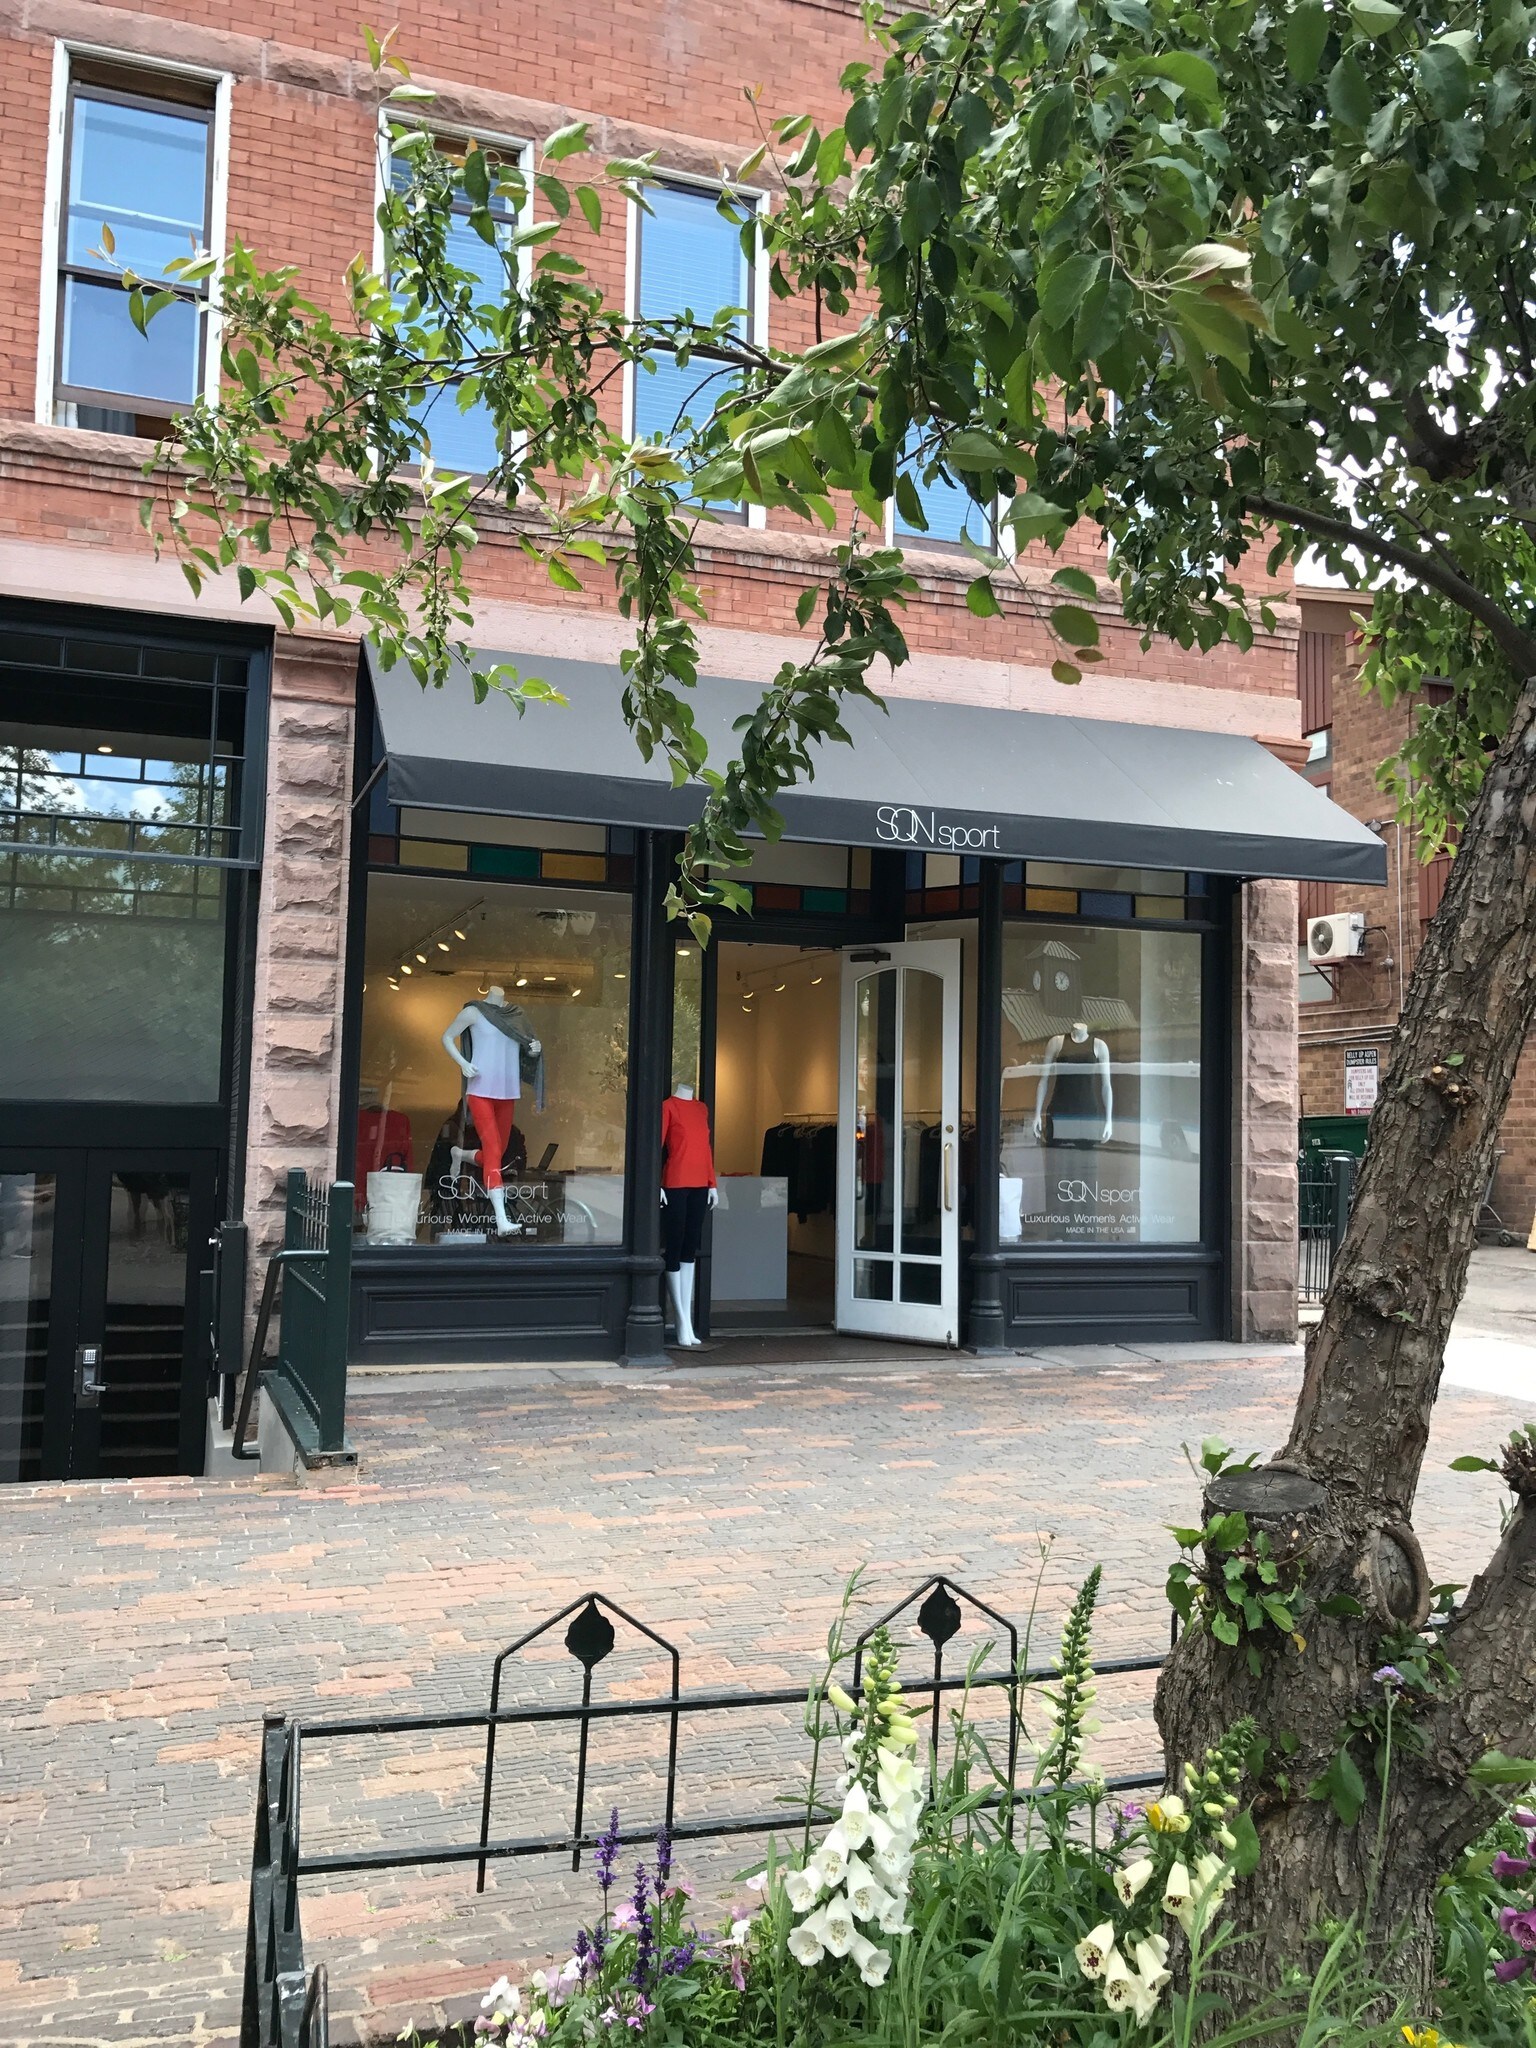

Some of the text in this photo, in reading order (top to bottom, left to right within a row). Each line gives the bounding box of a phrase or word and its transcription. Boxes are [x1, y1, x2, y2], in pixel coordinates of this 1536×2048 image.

[516, 1212, 552, 1224] Active
[556, 1212, 588, 1224] Wear
[1024, 1213, 1071, 1224] Luxurious
[1073, 1213, 1116, 1224] Women's
[1065, 1226, 1125, 1234] MADE IN THE USA
